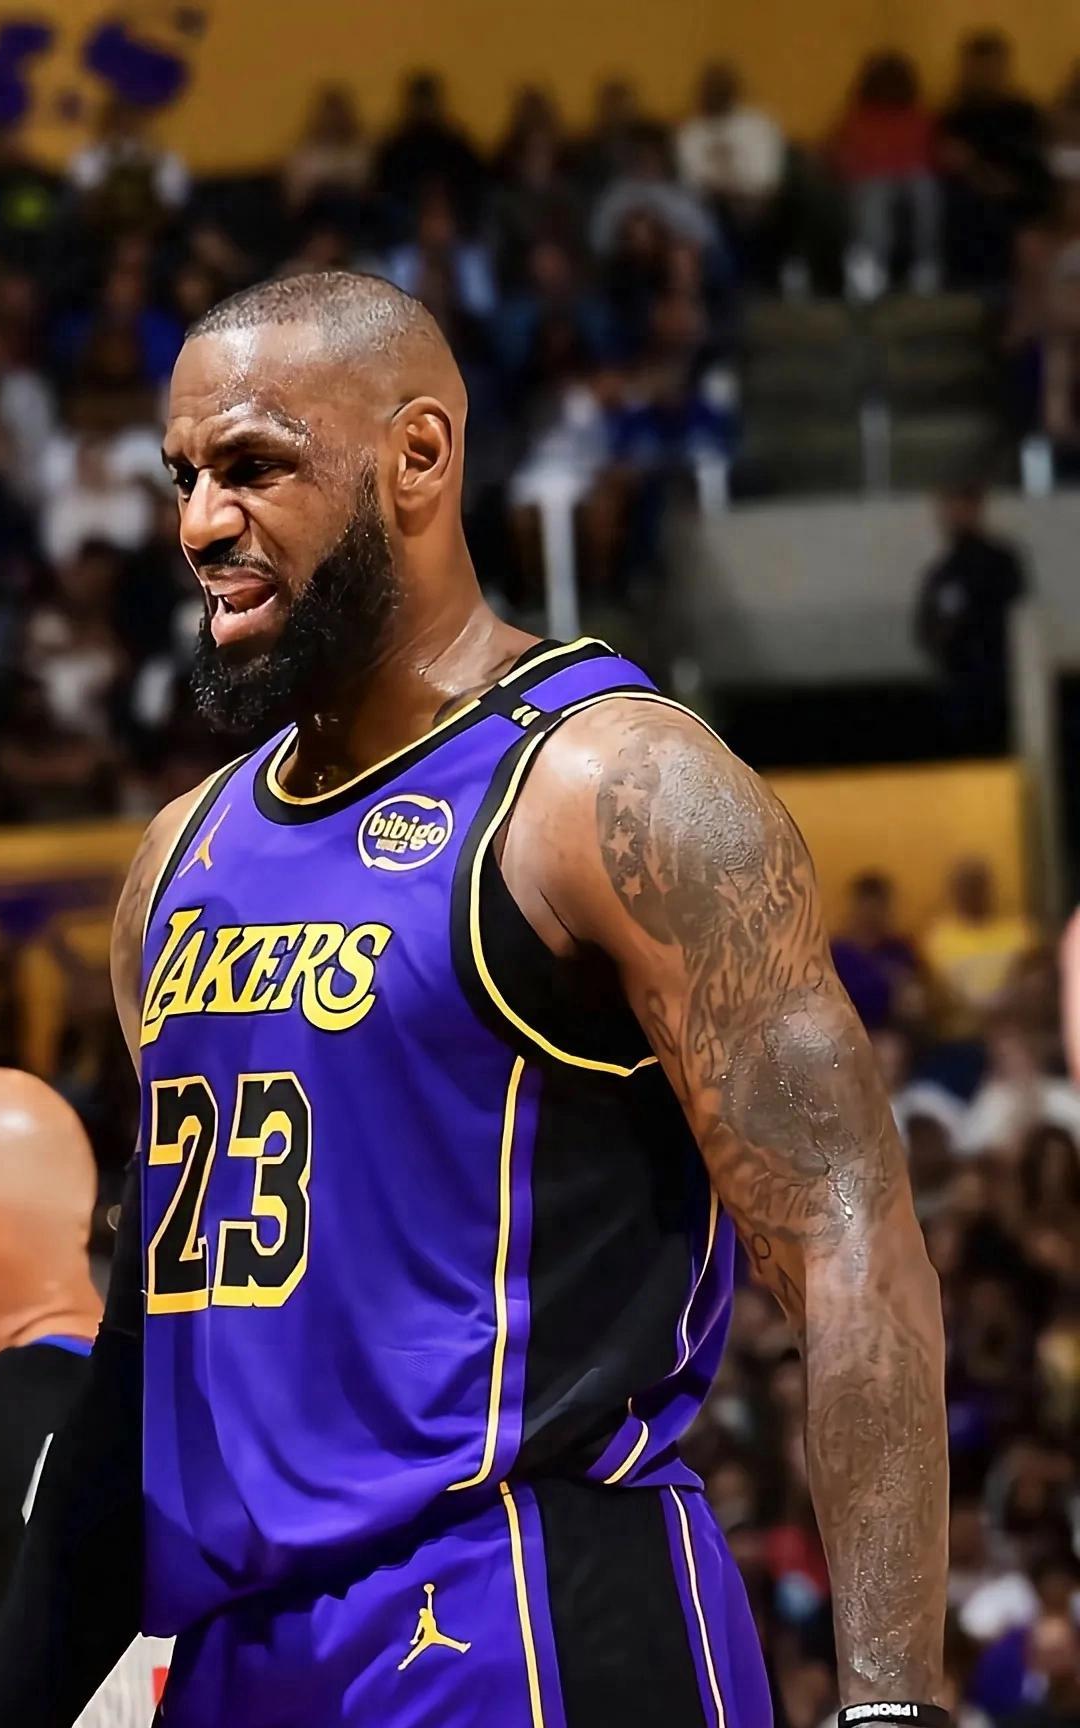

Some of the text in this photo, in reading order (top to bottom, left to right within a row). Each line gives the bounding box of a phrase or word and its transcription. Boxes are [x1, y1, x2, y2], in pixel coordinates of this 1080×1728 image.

[367, 811, 446, 851] bibigo
[139, 905, 394, 1049] LAKERS
[146, 1071, 313, 1315] 23
